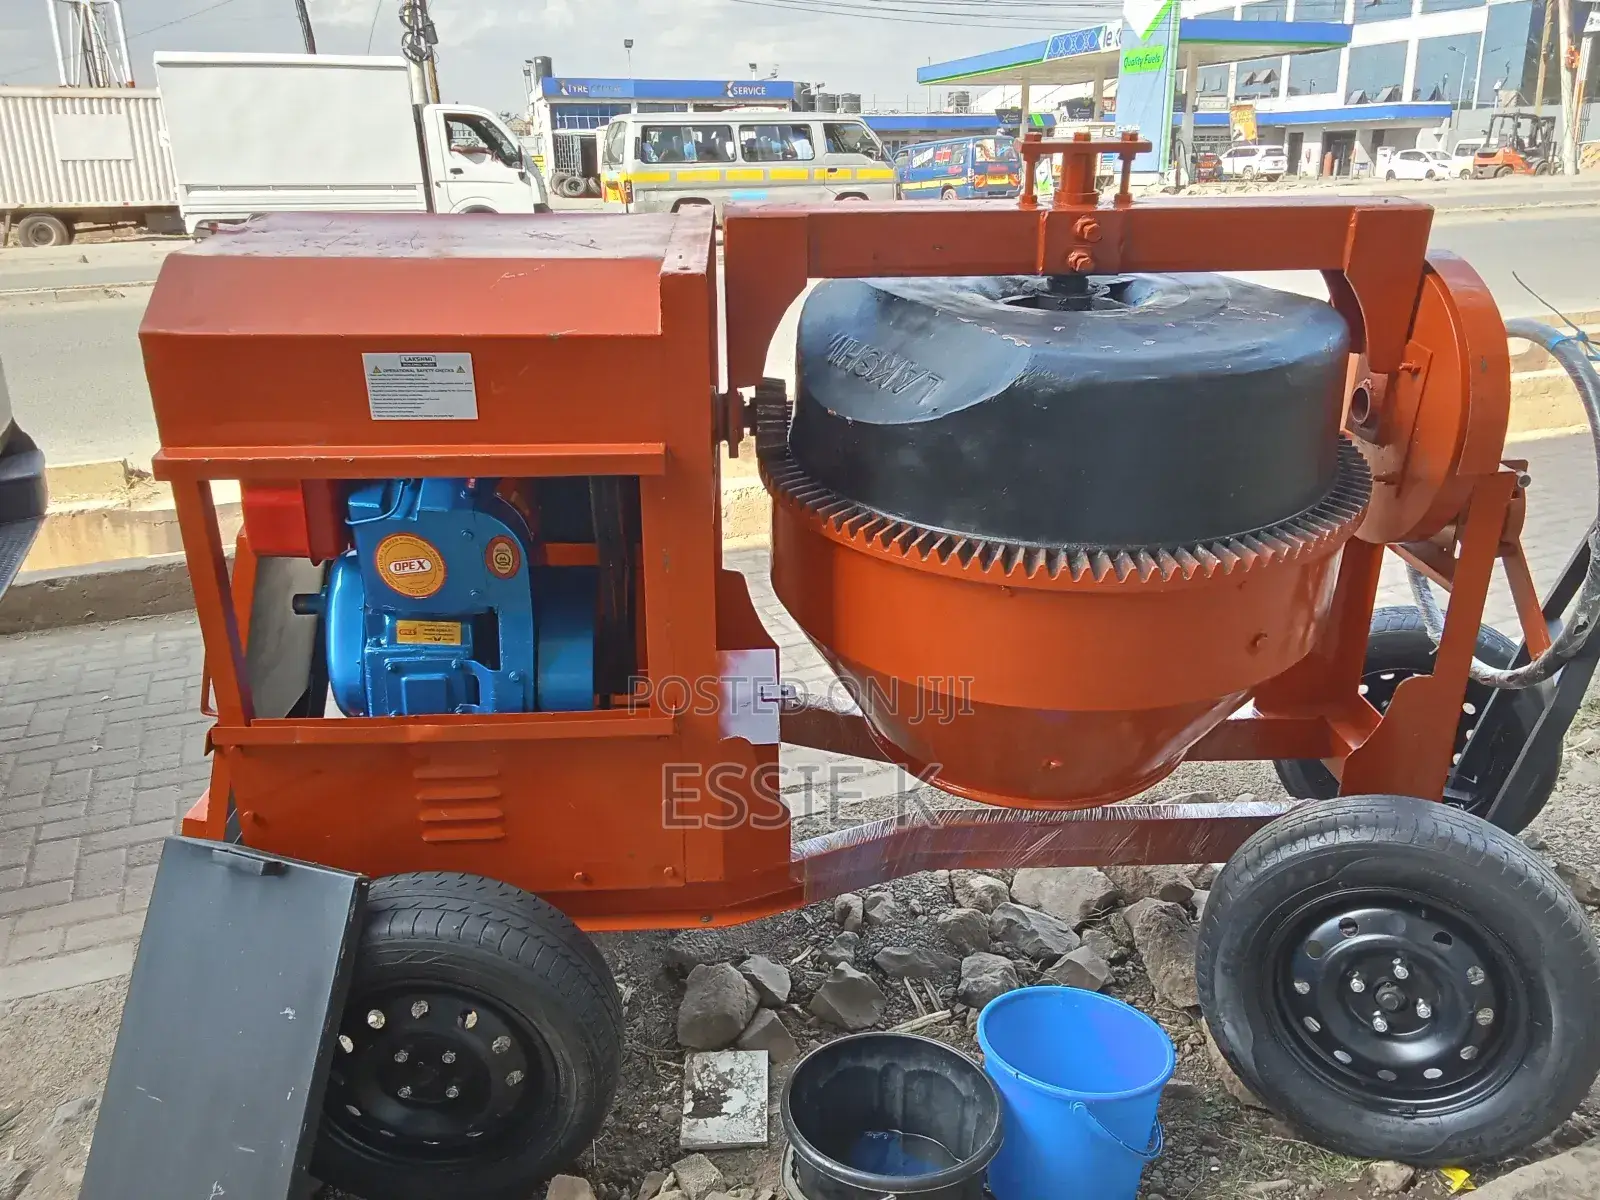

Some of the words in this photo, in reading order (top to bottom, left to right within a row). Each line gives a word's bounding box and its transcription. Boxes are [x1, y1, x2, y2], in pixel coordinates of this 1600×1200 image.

[1123, 55, 1143, 69] Quality
[1144, 53, 1161, 65] Fuels
[567, 84, 589, 93] TYRE
[733, 86, 766, 95] SERVICE
[394, 559, 426, 572] OPEX
